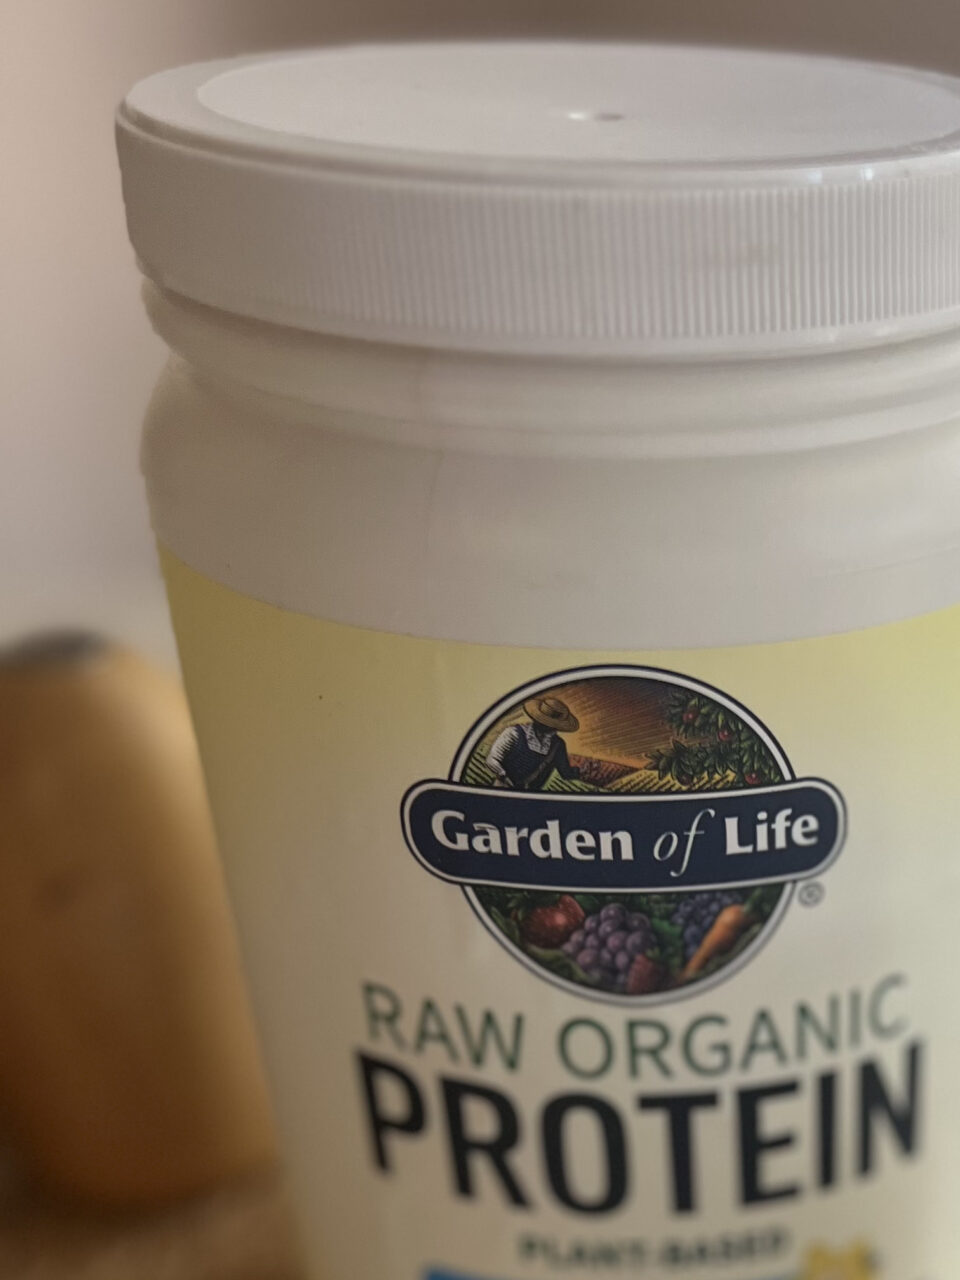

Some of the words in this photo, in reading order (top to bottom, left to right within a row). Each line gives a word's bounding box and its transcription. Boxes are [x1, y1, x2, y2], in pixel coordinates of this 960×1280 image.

[430, 810, 634, 861] Garden
[653, 808, 715, 878] of
[725, 808, 820, 856] Life
[360, 980, 525, 1073] RAW
[556, 973, 909, 1081] ORGANIC
[354, 1038, 926, 1219] PROTEIN
